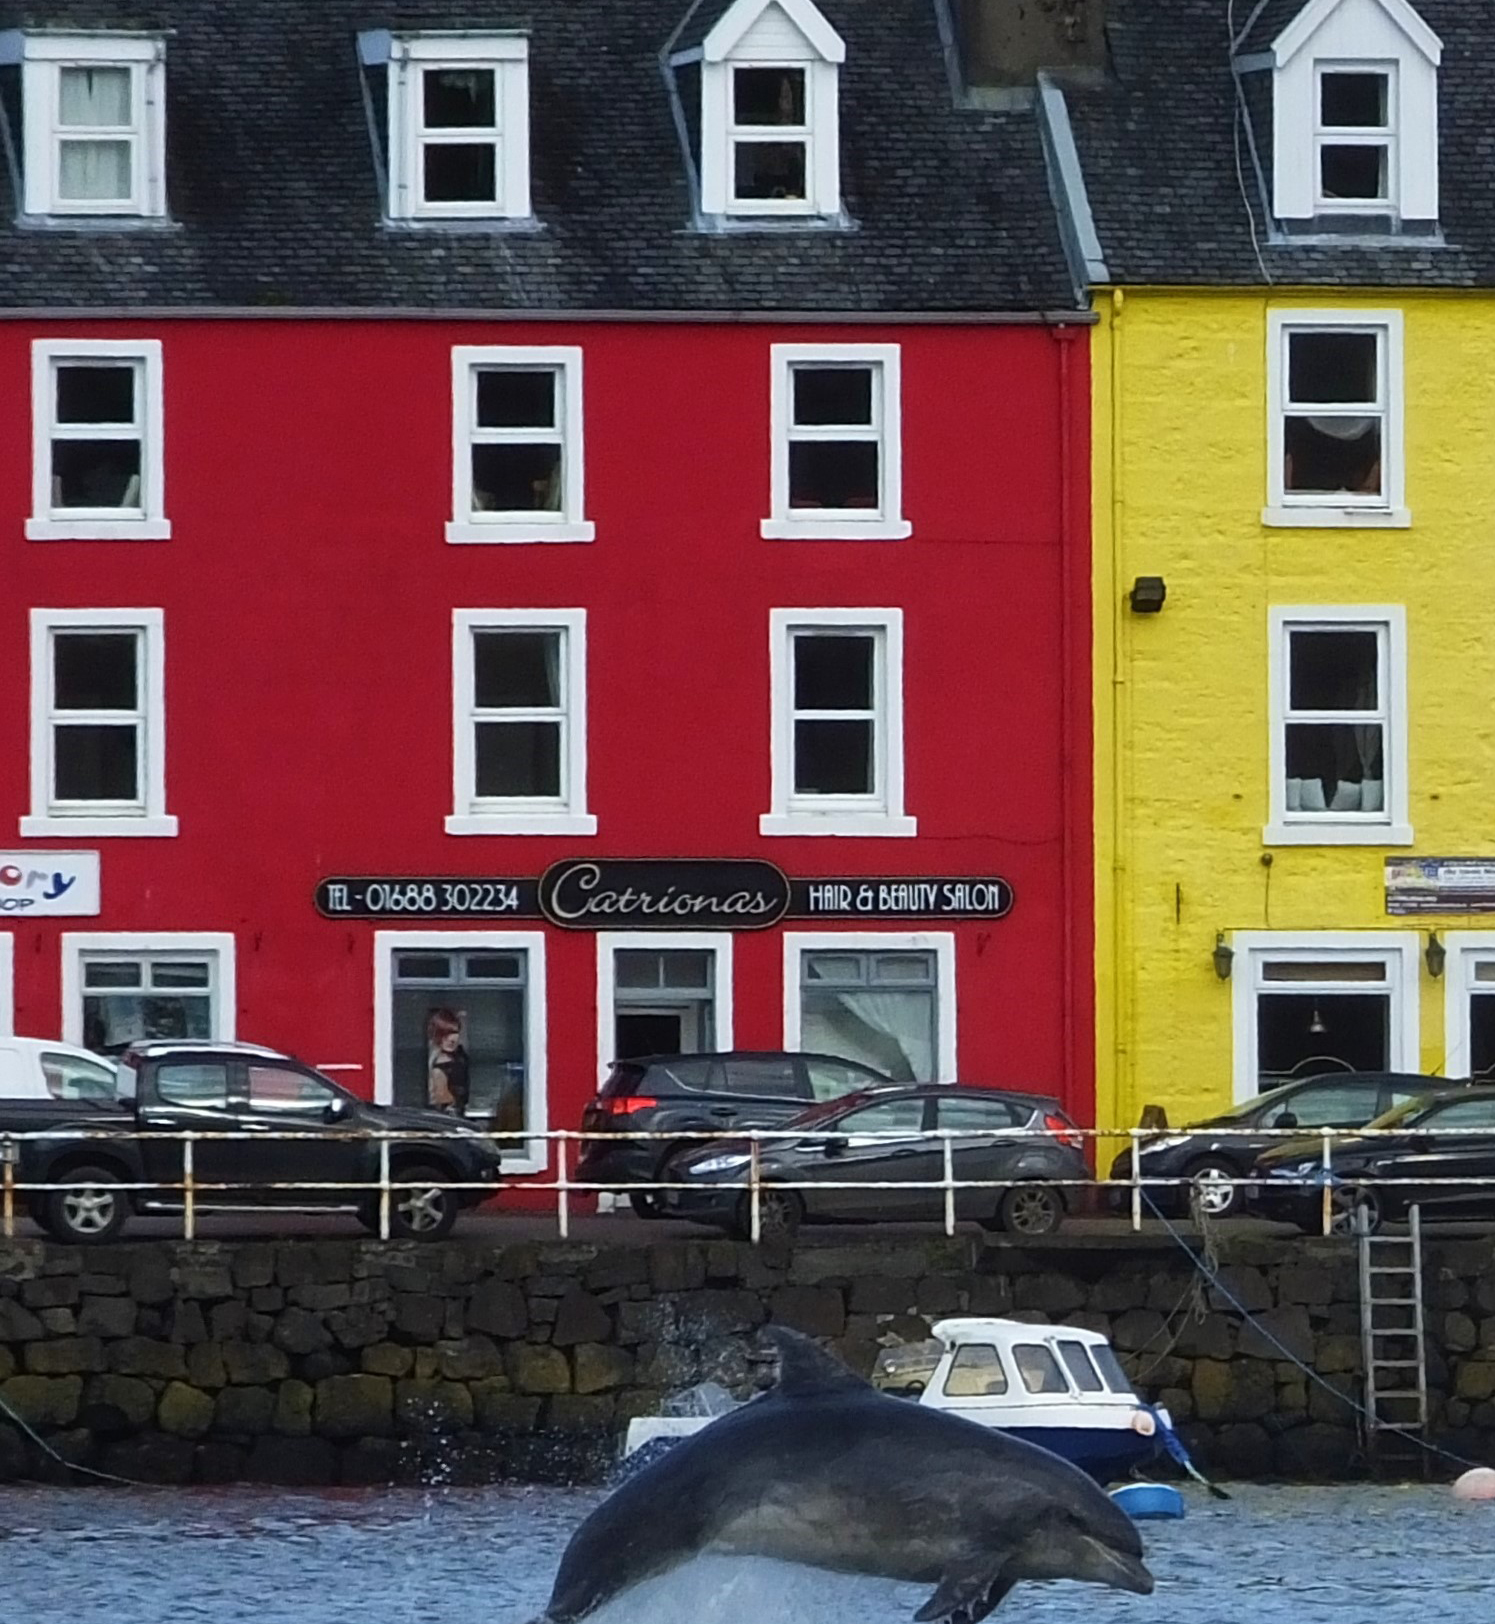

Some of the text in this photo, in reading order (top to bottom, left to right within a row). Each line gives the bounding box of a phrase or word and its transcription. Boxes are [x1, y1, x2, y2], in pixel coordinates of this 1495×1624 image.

[326, 883, 352, 911] TEL
[365, 883, 437, 912] 01688
[440, 884, 519, 911] 302234
[551, 863, 778, 919] Catrionas
[809, 883, 1000, 911] HAIR & BEAUTY SALON
